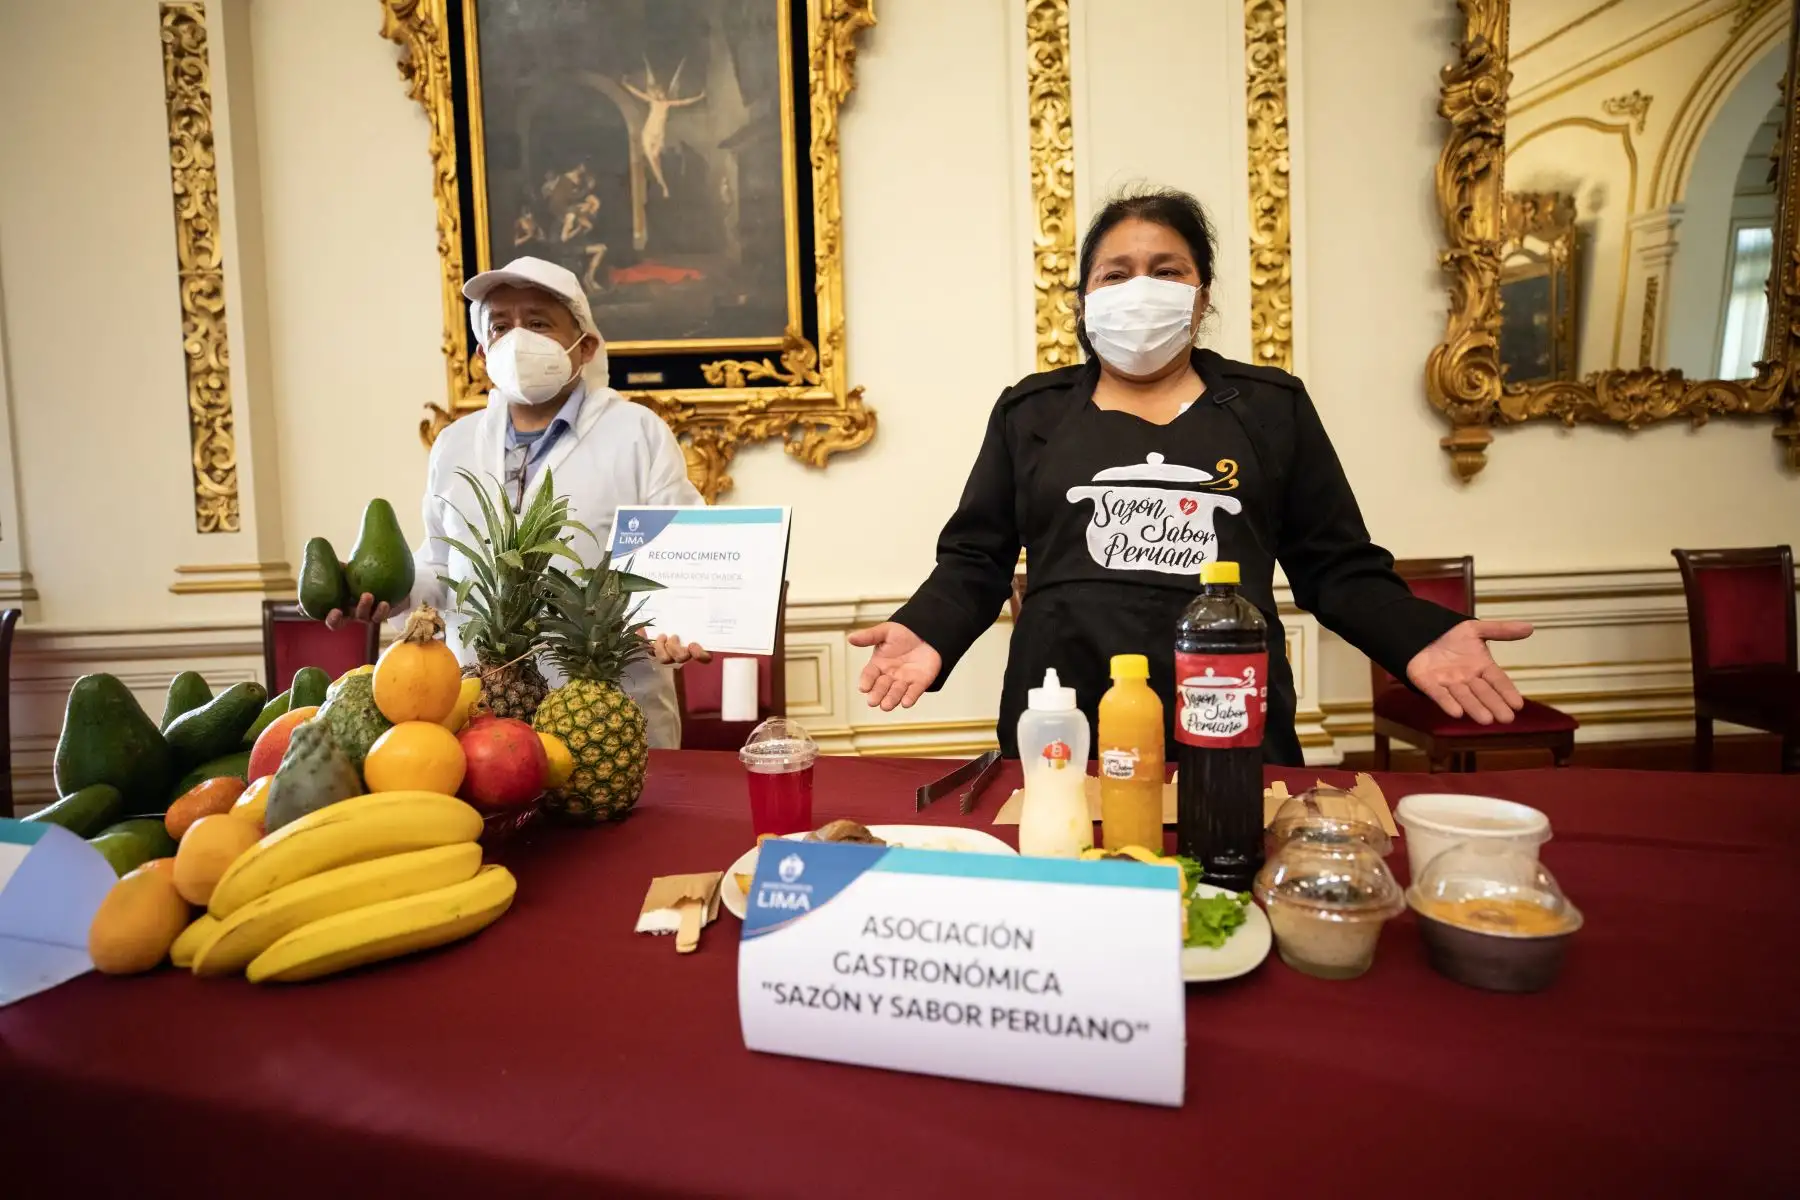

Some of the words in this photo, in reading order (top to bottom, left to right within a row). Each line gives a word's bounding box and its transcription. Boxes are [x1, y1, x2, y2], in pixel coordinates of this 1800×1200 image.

[1094, 490, 1167, 528] Sazón
[619, 535, 644, 545] LIMA
[1140, 515, 1216, 545] Sabor
[648, 551, 741, 562] RECONOCIMIENTO
[1104, 532, 1208, 568] Peruano
[757, 890, 811, 911] LIMA
[861, 914, 1034, 952] ASOCIACIÓN
[833, 950, 1063, 996] GASTRONÓMICA
[867, 994, 886, 1015] Y
[890, 996, 983, 1027] SABOR
